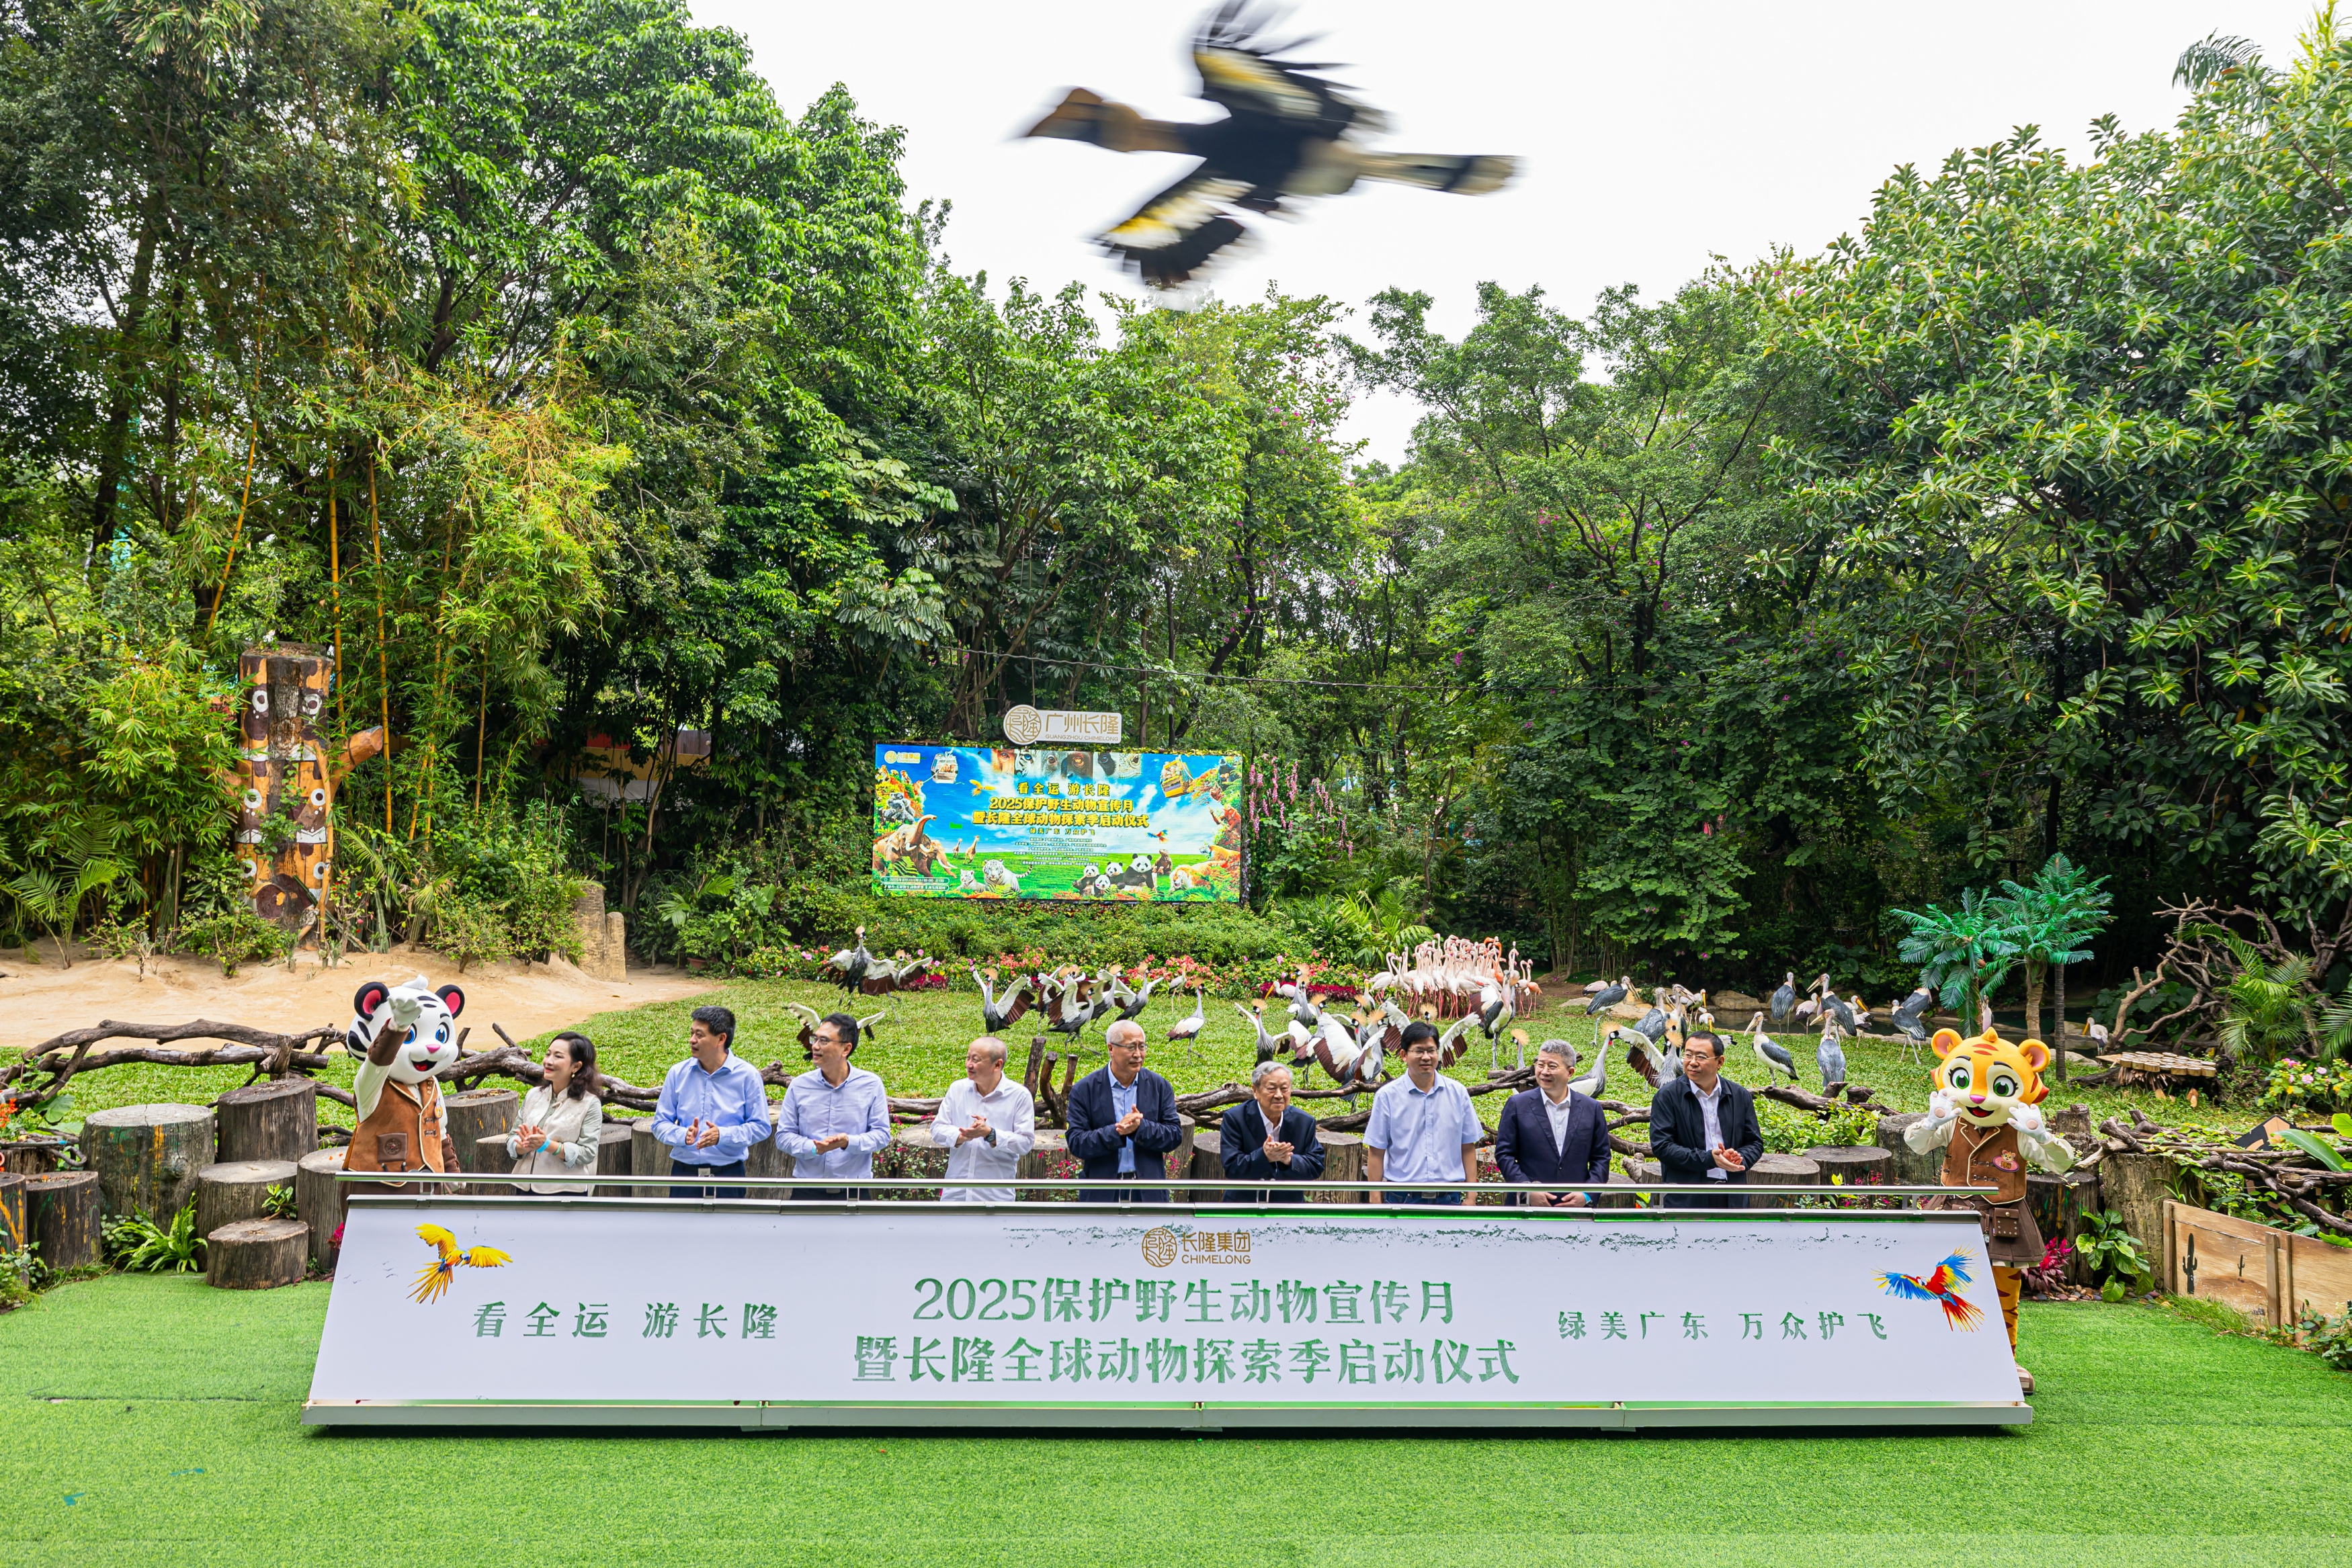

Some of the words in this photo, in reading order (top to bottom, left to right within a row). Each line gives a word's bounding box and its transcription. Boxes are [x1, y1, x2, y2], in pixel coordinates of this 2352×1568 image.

[1046, 713, 1119, 734] 广州长隆
[1017, 782, 1060, 795] 看全运
[1068, 783, 1110, 796] 游长隆
[989, 797, 1134, 812] 2025保护野生动物宣传月
[972, 811, 1150, 828] 暨长隆全球动物探索季启动仪式
[1181, 1232, 1251, 1252] 长隆集团
[1181, 1254, 1251, 1264] CHIMELONG
[914, 1277, 1454, 1323] 2025保护野生动物宣传月
[474, 1301, 608, 1338] 看全运
[642, 1303, 779, 1339] 游长隆
[1558, 1311, 1708, 1340] 绿美广东
[1738, 1311, 1887, 1340] 万众护飞
[853, 1336, 1519, 1384] 暨长隆全球动物探索季启动仪式
